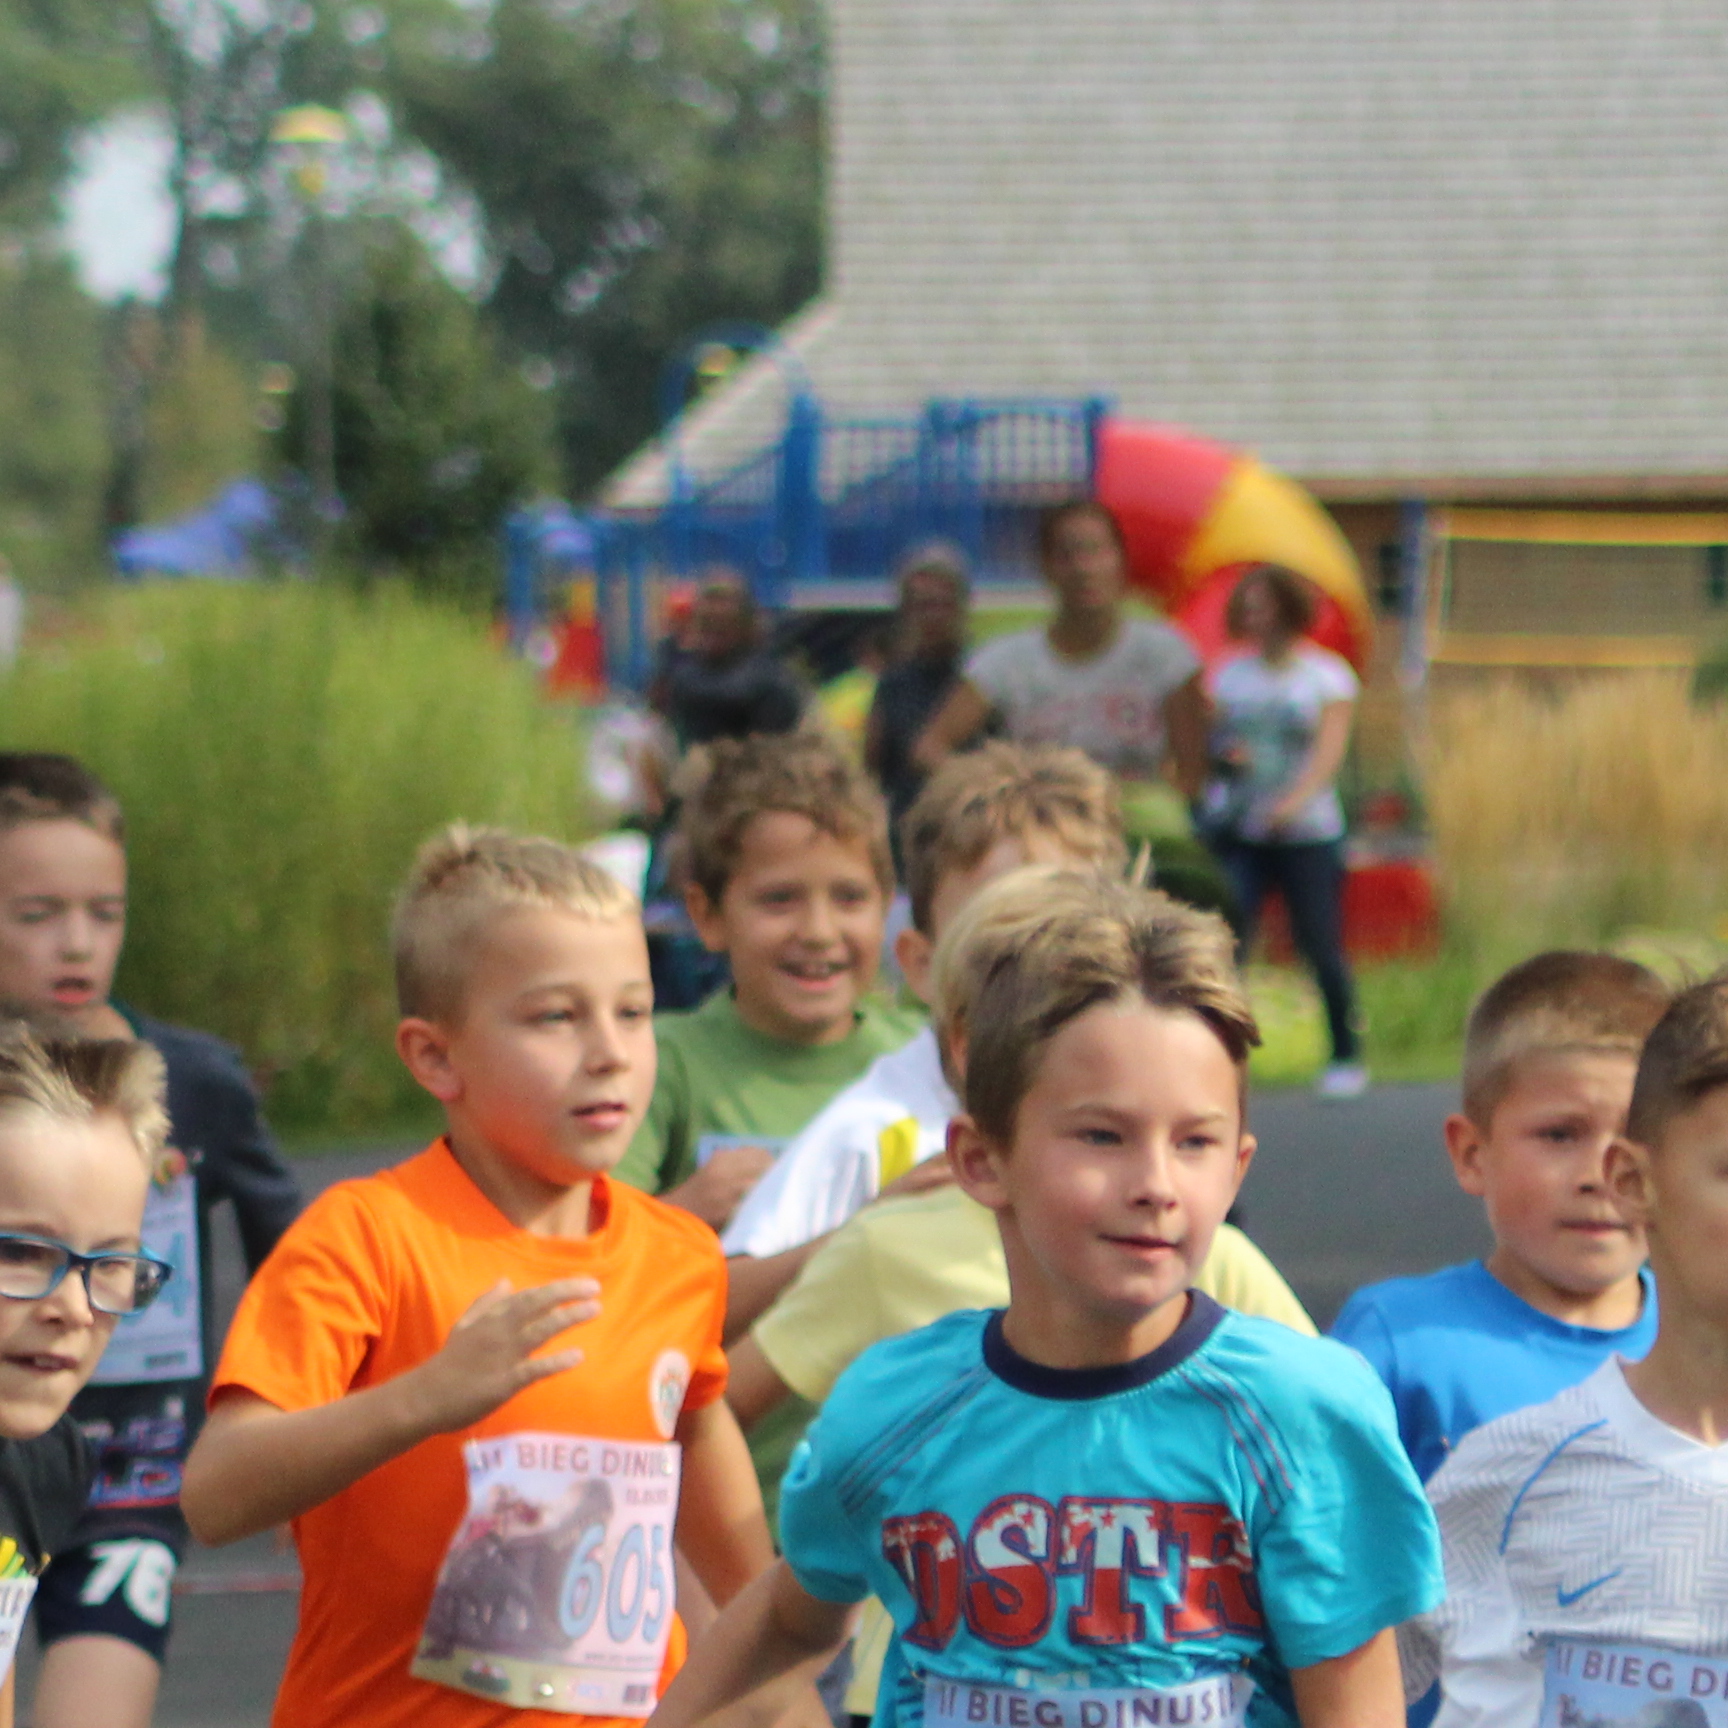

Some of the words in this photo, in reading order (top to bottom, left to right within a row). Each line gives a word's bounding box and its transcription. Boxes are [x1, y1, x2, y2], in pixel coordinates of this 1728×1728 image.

[516, 1443, 590, 1474] BIEG
[1556, 1645, 1575, 1678] II
[1582, 1650, 1674, 1692] BIEG
[938, 1684, 957, 1718] II
